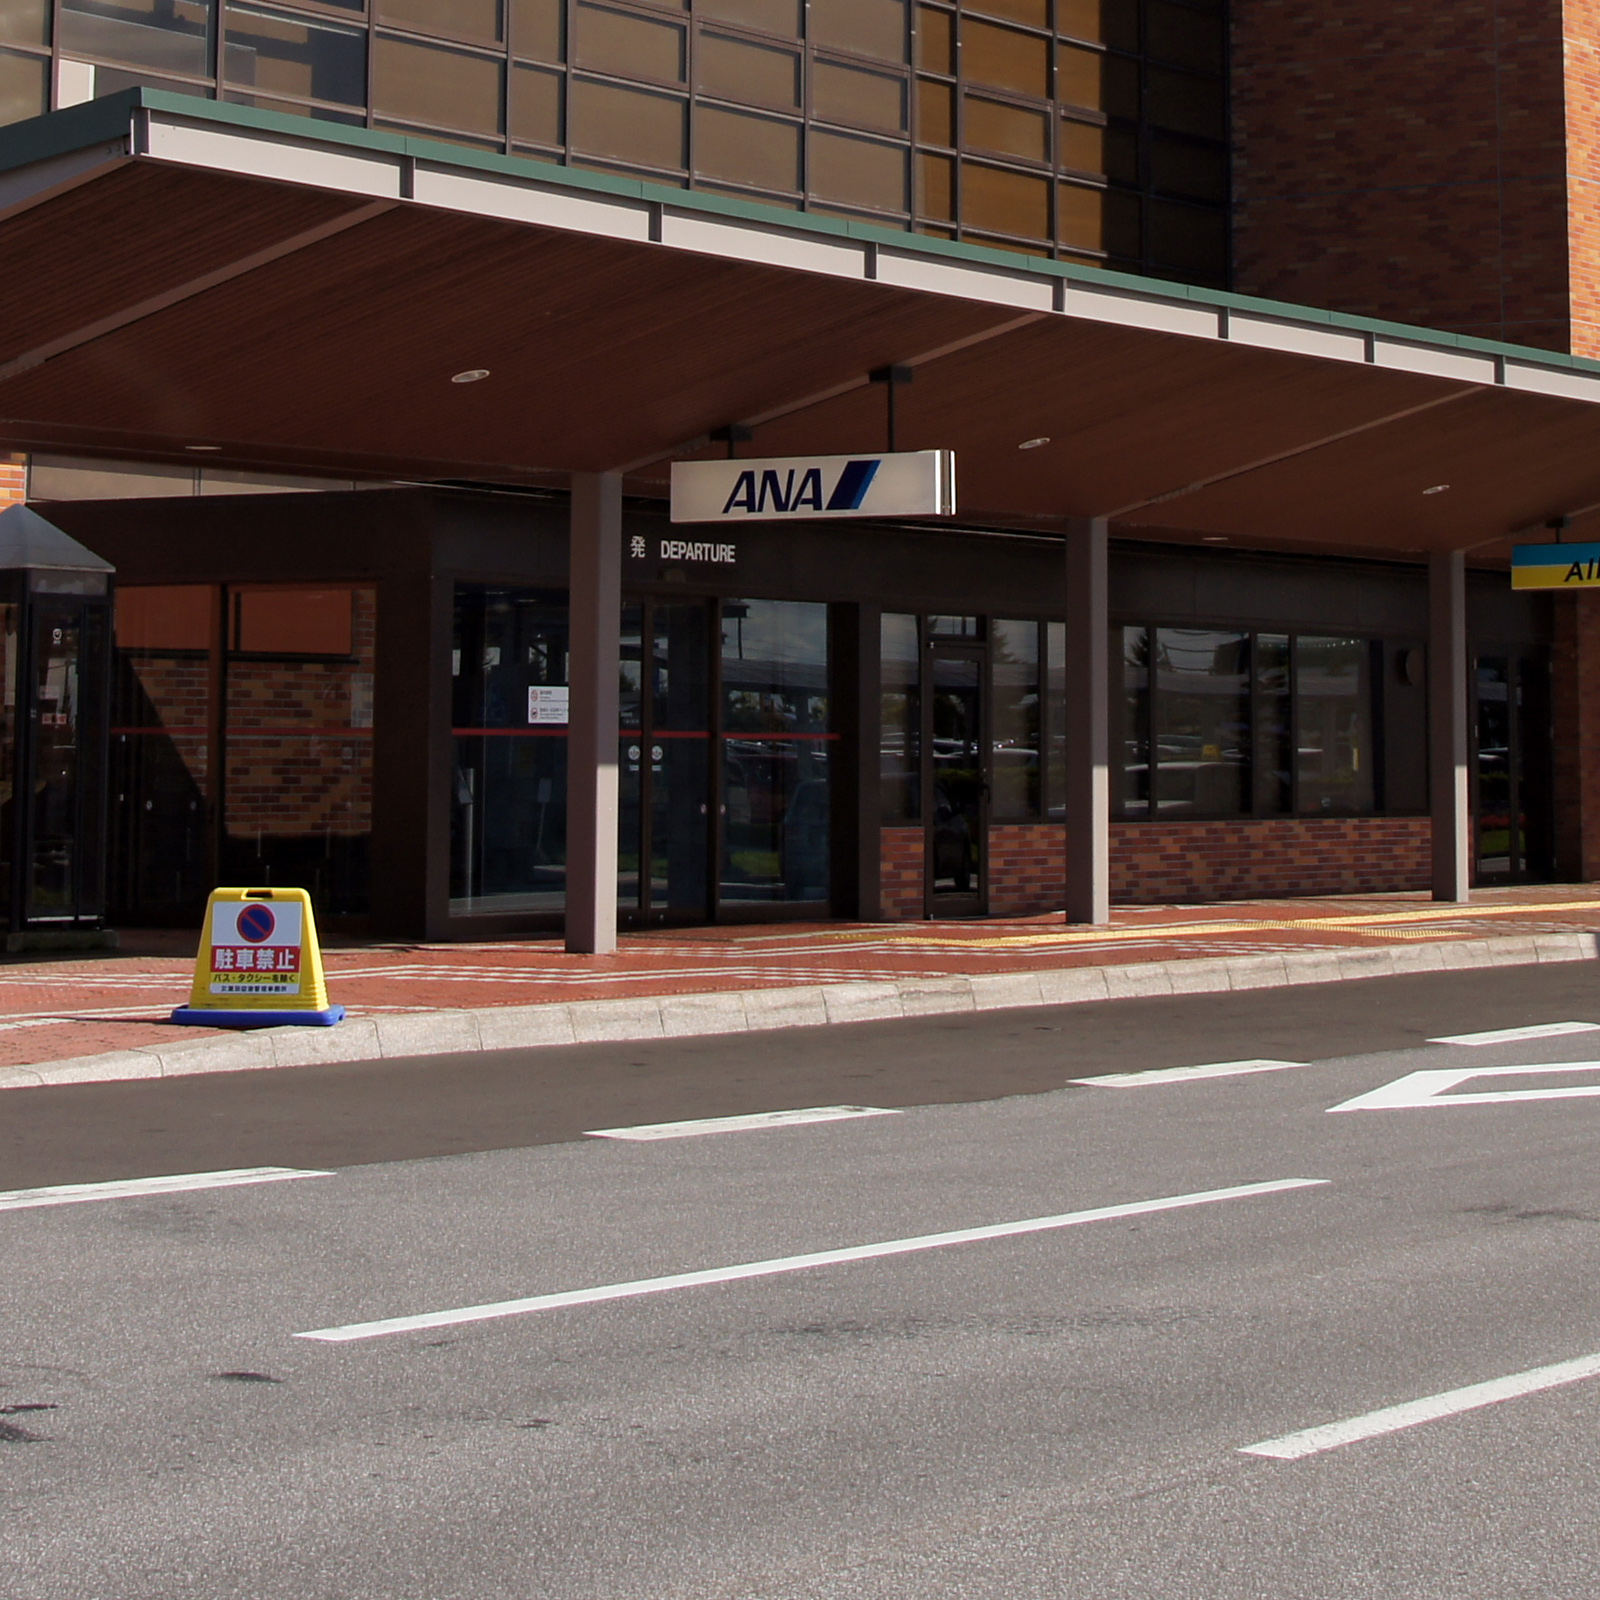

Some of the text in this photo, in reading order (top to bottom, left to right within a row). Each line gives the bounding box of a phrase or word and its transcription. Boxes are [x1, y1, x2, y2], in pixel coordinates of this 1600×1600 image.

[721, 468, 823, 514] ANA
[630, 535, 646, 558] 発
[660, 540, 736, 563] DEPARTURE
[215, 948, 295, 970] 駐車禁止
[213, 973, 296, 983] バス・タクシーを除く
